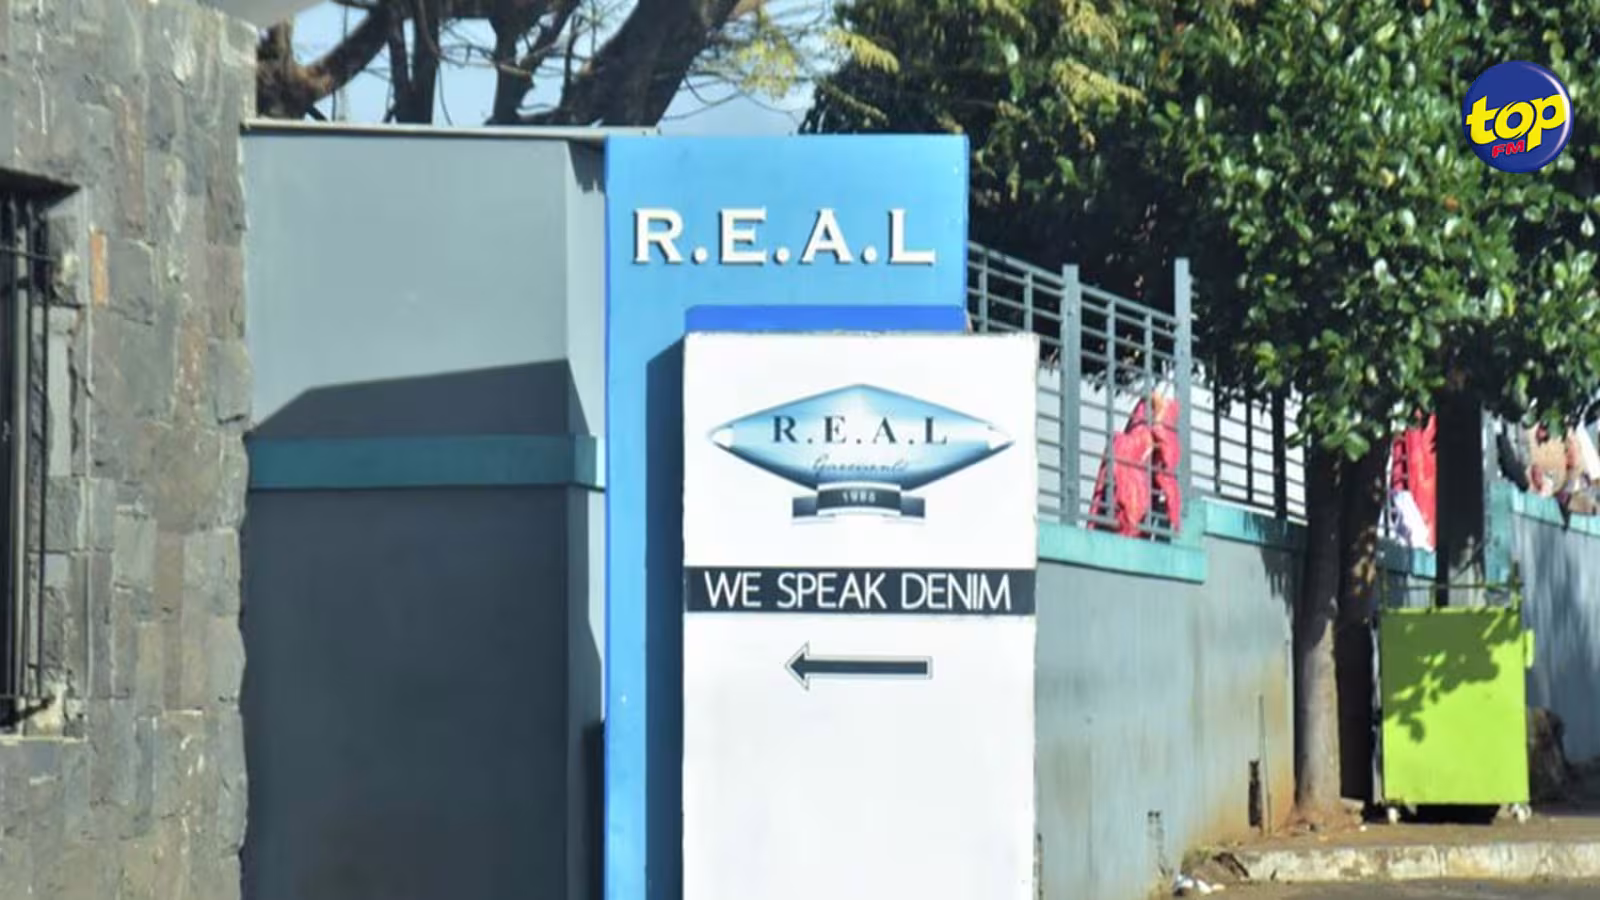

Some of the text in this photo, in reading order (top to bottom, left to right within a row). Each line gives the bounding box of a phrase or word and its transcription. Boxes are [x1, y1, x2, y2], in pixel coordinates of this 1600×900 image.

[632, 207, 936, 266] R.E.A.L
[771, 415, 948, 445] R.E.A.L
[704, 570, 1012, 612] WE SPEAK DENIM
